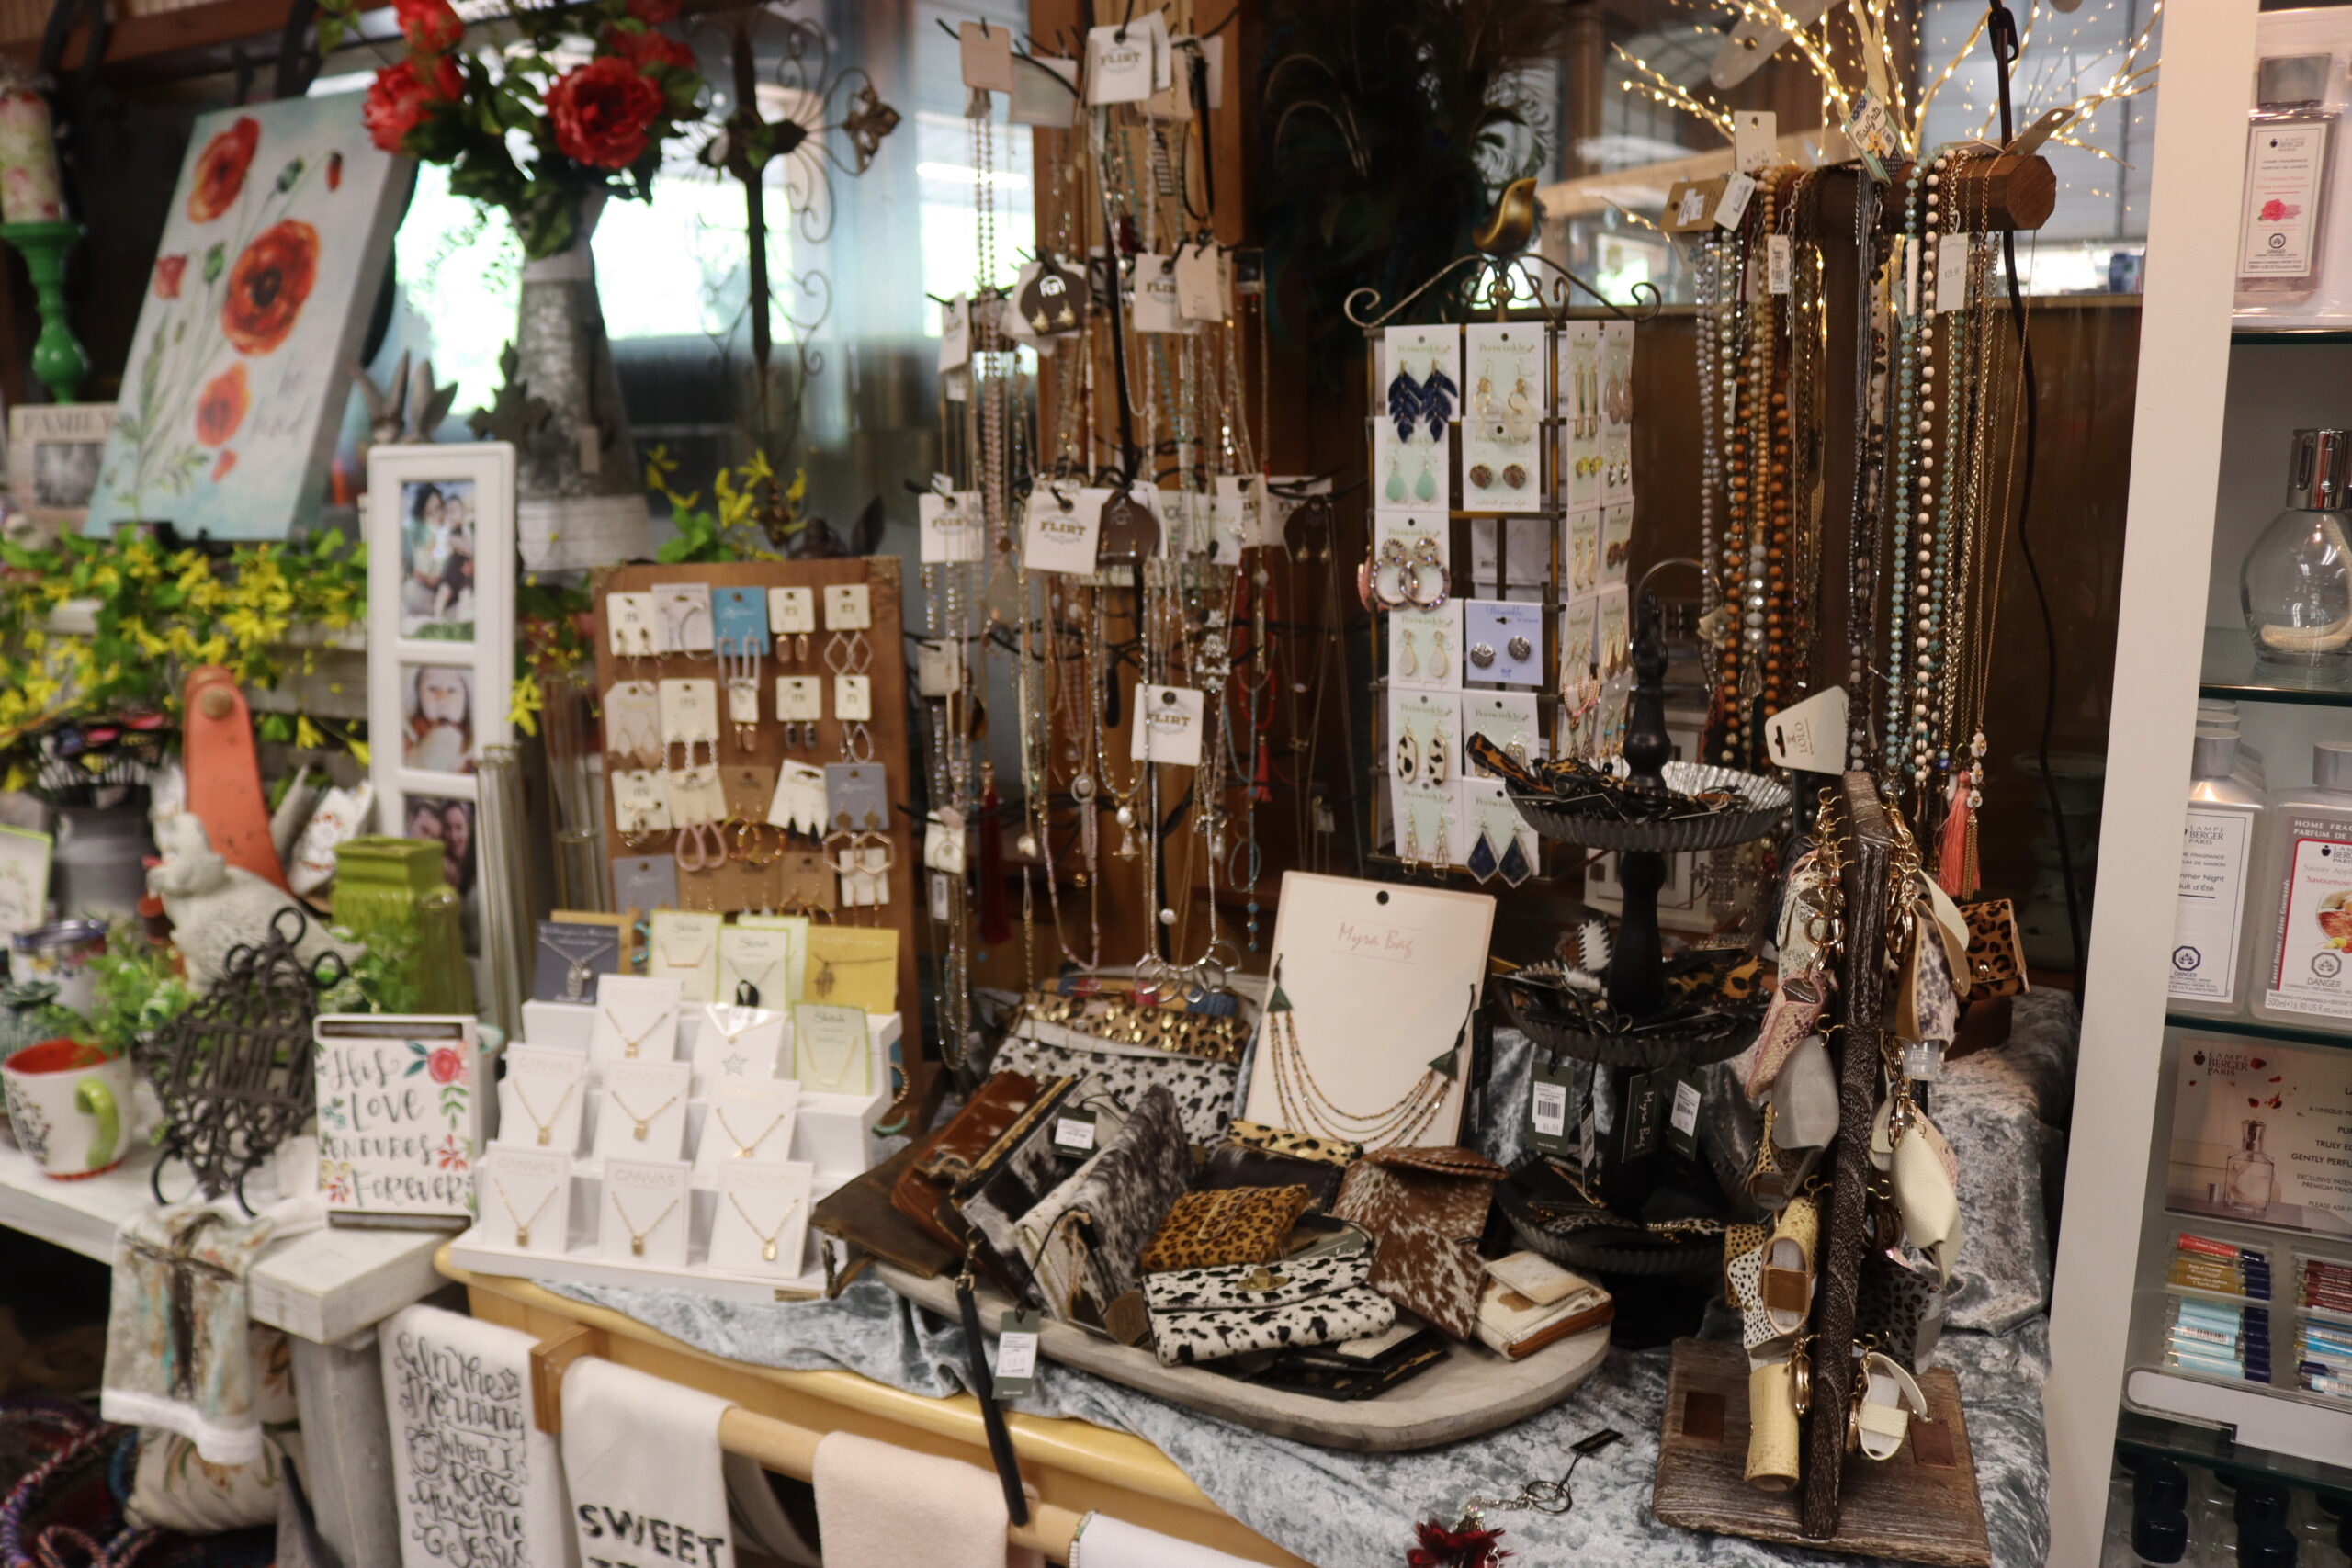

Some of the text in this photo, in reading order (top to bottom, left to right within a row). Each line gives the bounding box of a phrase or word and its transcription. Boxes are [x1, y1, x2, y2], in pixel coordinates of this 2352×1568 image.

[1146, 281, 1176, 294] FLIR
[1039, 520, 1088, 537] FLIRT
[1476, 796, 1514, 808] Periwink
[2189, 824, 2224, 832] LAMPE
[2293, 820, 2324, 829] HOME
[2189, 830, 2224, 840] BERGER
[2292, 829, 2330, 838] PARFUM
[2202, 874, 2225, 883] Night
[1338, 921, 1415, 960] Myra Bag
[2174, 970, 2198, 978] DANGER
[2306, 977, 2342, 987] DANGER
[2209, 1051, 2248, 1062] LAMPE
[2208, 1058, 2248, 1071] BERGER
[2207, 1067, 2235, 1077] PARIS
[2315, 1106, 2344, 1116] UNIQUE
[2315, 1139, 2342, 1149] TRULY
[2290, 1153, 2325, 1164] GENTLY
[616, 1169, 676, 1187] CANVAS
[2296, 1173, 2332, 1184] EXCLUSIVE
[2301, 1181, 2333, 1191] PREMIUM
[2308, 1201, 2331, 1210] PLEASE
[578, 1504, 725, 1568] SWEET
